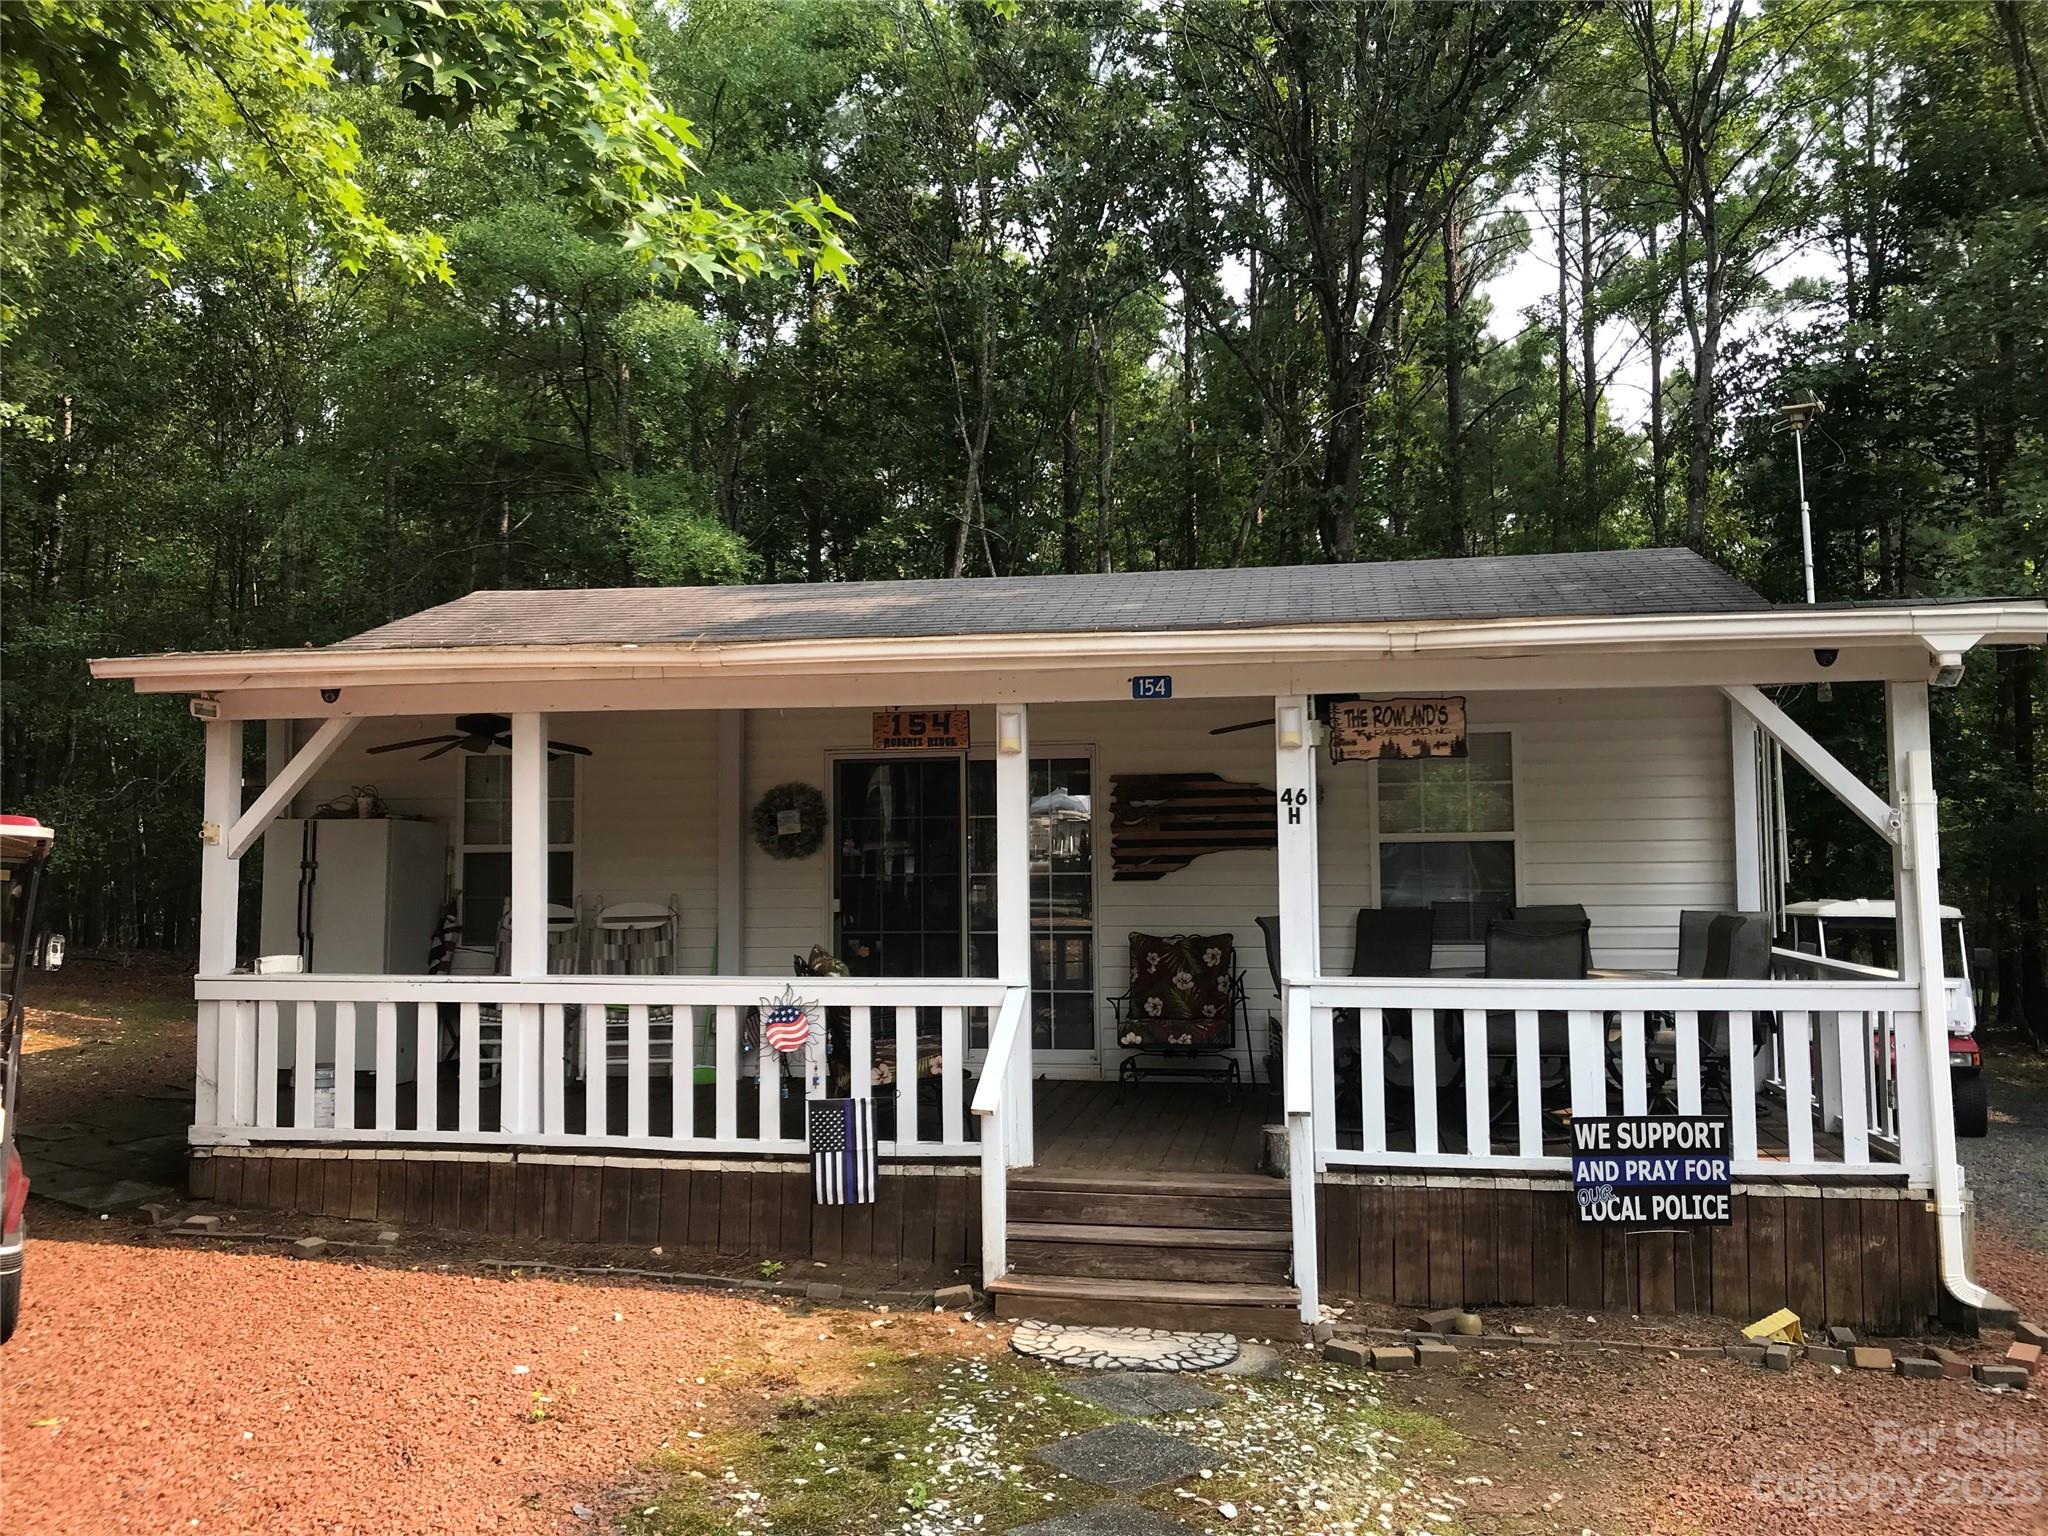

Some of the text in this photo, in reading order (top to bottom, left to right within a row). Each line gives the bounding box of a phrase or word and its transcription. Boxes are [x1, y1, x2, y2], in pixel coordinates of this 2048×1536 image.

[1138, 678, 1166, 696] 154
[892, 712, 952, 736] 154
[1344, 704, 1449, 729] THE ROWLAND'S
[1280, 787, 1308, 806] 46
[1288, 806, 1301, 825] H
[1574, 1121, 1725, 1150] WE SUPPORT
[1576, 1159, 1728, 1183] AND PRAY FOR
[1577, 1183, 1617, 1207] OUR
[1581, 1194, 1729, 1222] LOCAL POLICE
